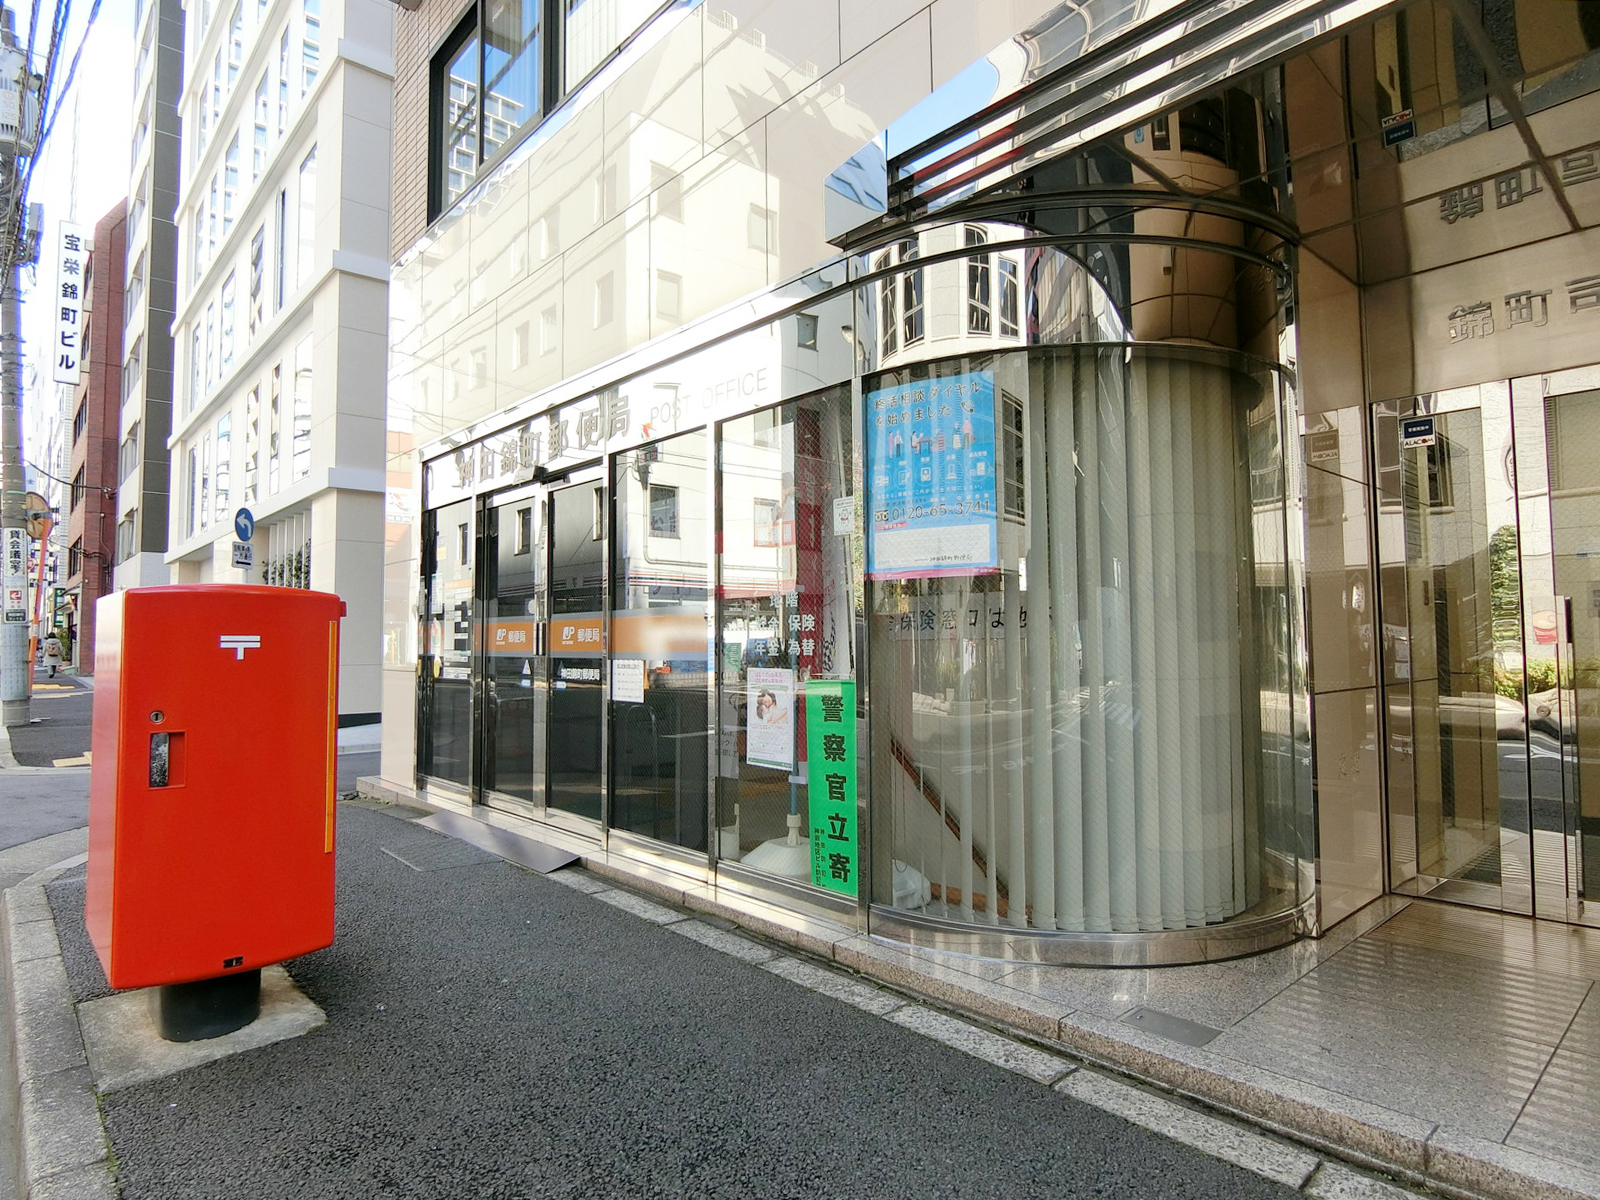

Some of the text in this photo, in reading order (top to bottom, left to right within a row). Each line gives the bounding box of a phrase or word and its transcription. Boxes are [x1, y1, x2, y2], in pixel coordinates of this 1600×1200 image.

[59, 234, 81, 370] 宝栄錦町ビル
[651, 368, 767, 425] POST OFFICE
[876, 404, 951, 428] を始めました
[456, 394, 631, 489] 神田錦町郵便局
[892, 500, 990, 520] 0120-65-3741
[788, 614, 816, 633] 保険
[508, 630, 526, 644] 郵便局
[577, 628, 600, 643] 郵便局
[788, 638, 816, 657] 為替
[821, 694, 852, 883] 警察官立寄
